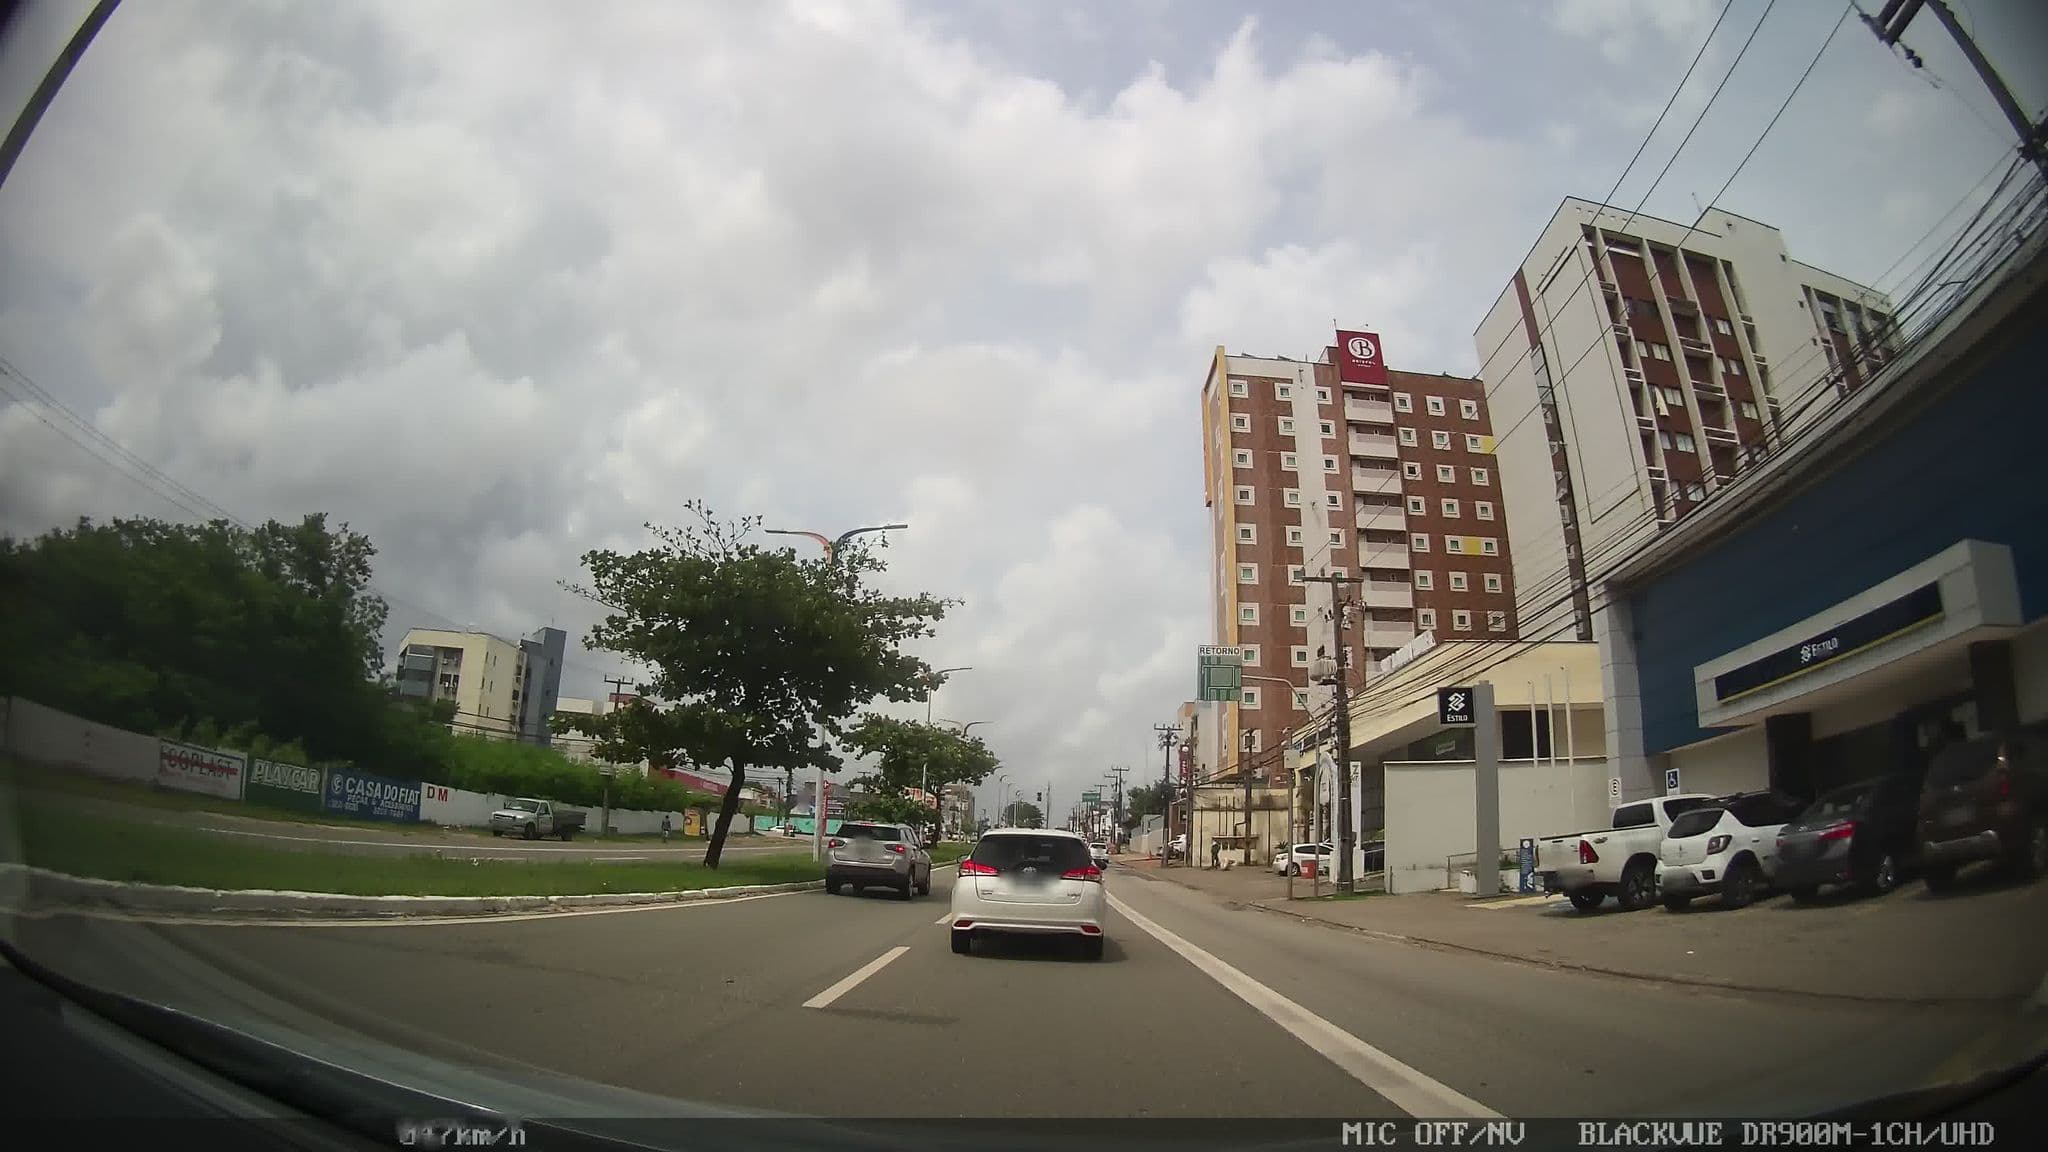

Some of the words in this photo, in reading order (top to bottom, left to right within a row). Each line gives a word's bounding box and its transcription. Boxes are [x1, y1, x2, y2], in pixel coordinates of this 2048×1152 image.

[1199, 647, 1240, 655] RETORNO
[1446, 714, 1468, 722] ESTILO
[250, 759, 321, 794] PLAYCAR
[346, 777, 382, 800] CASA
[383, 784, 398, 801] DO
[398, 787, 421, 806] FIAT
[426, 785, 436, 799] D
[437, 788, 449, 802] M
